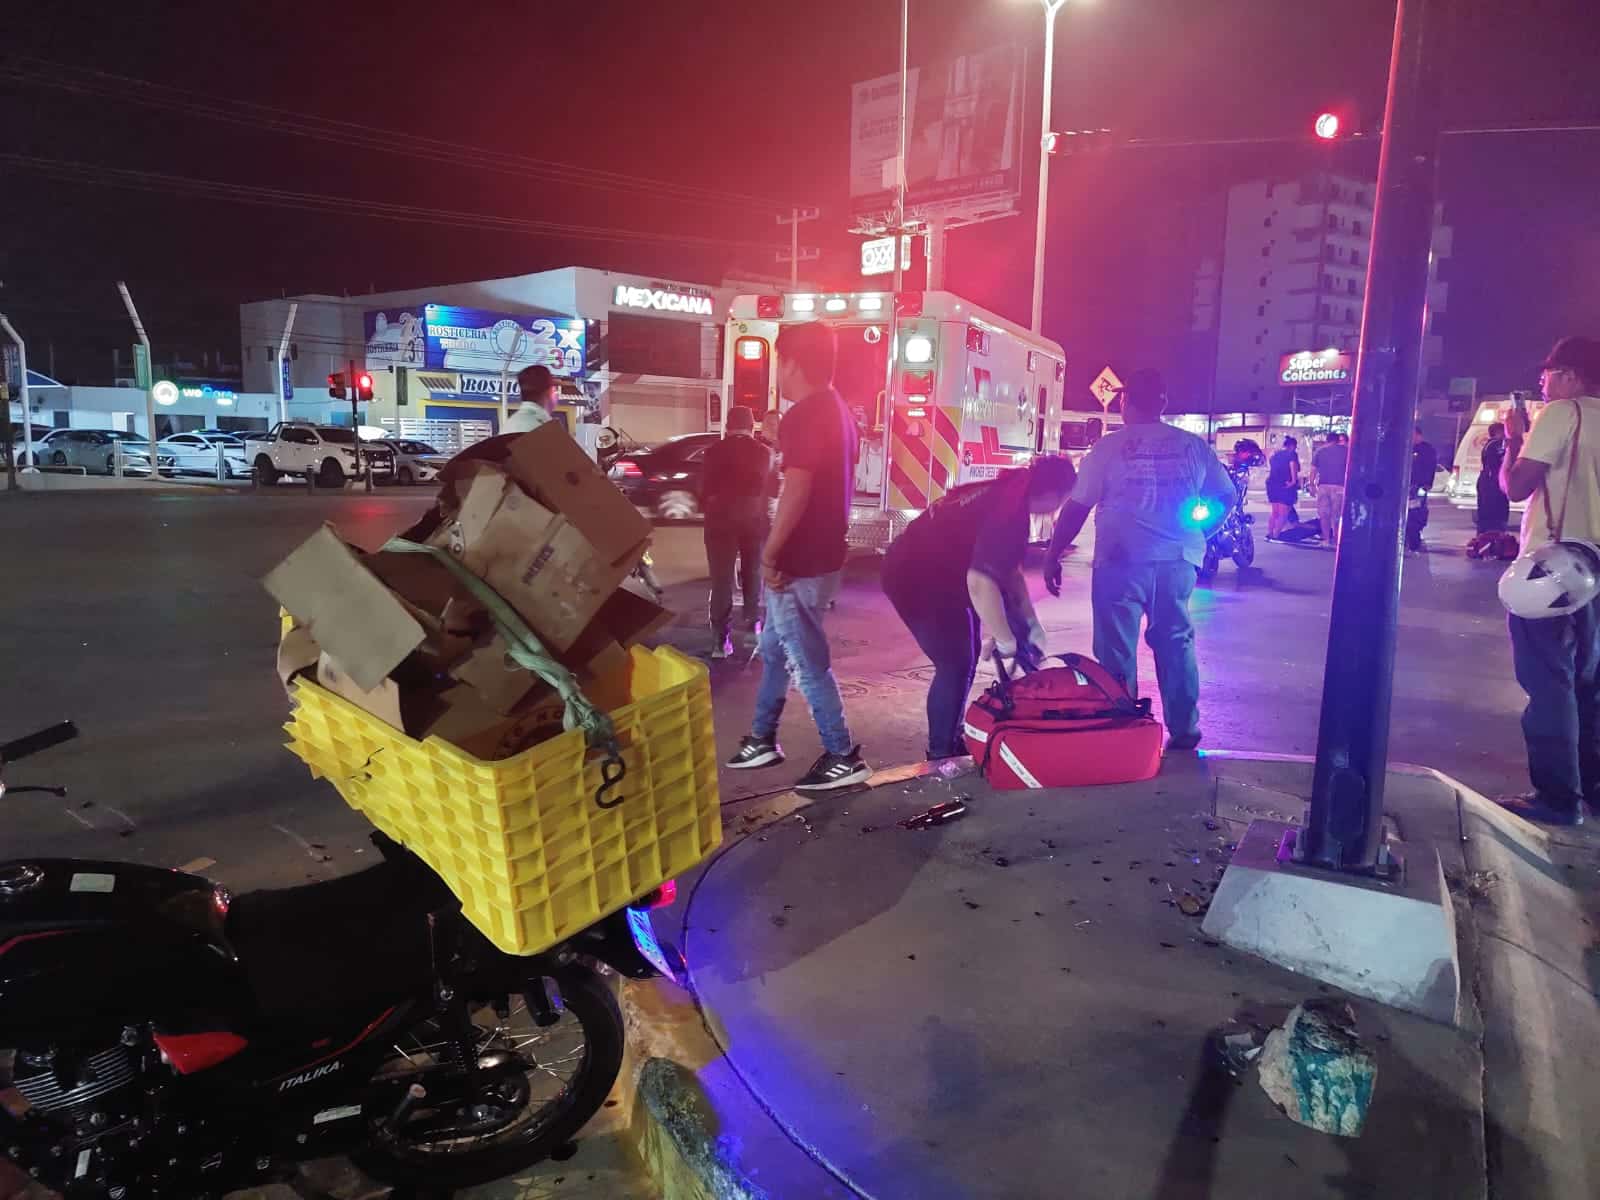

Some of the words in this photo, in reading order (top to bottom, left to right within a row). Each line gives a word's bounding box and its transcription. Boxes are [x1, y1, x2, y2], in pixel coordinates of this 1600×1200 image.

[615, 285, 713, 315] MEXICANA
[429, 326, 487, 340] ROSTICERIA
[1289, 357, 1326, 371] Super
[279, 1061, 340, 1091] ITALIKA
